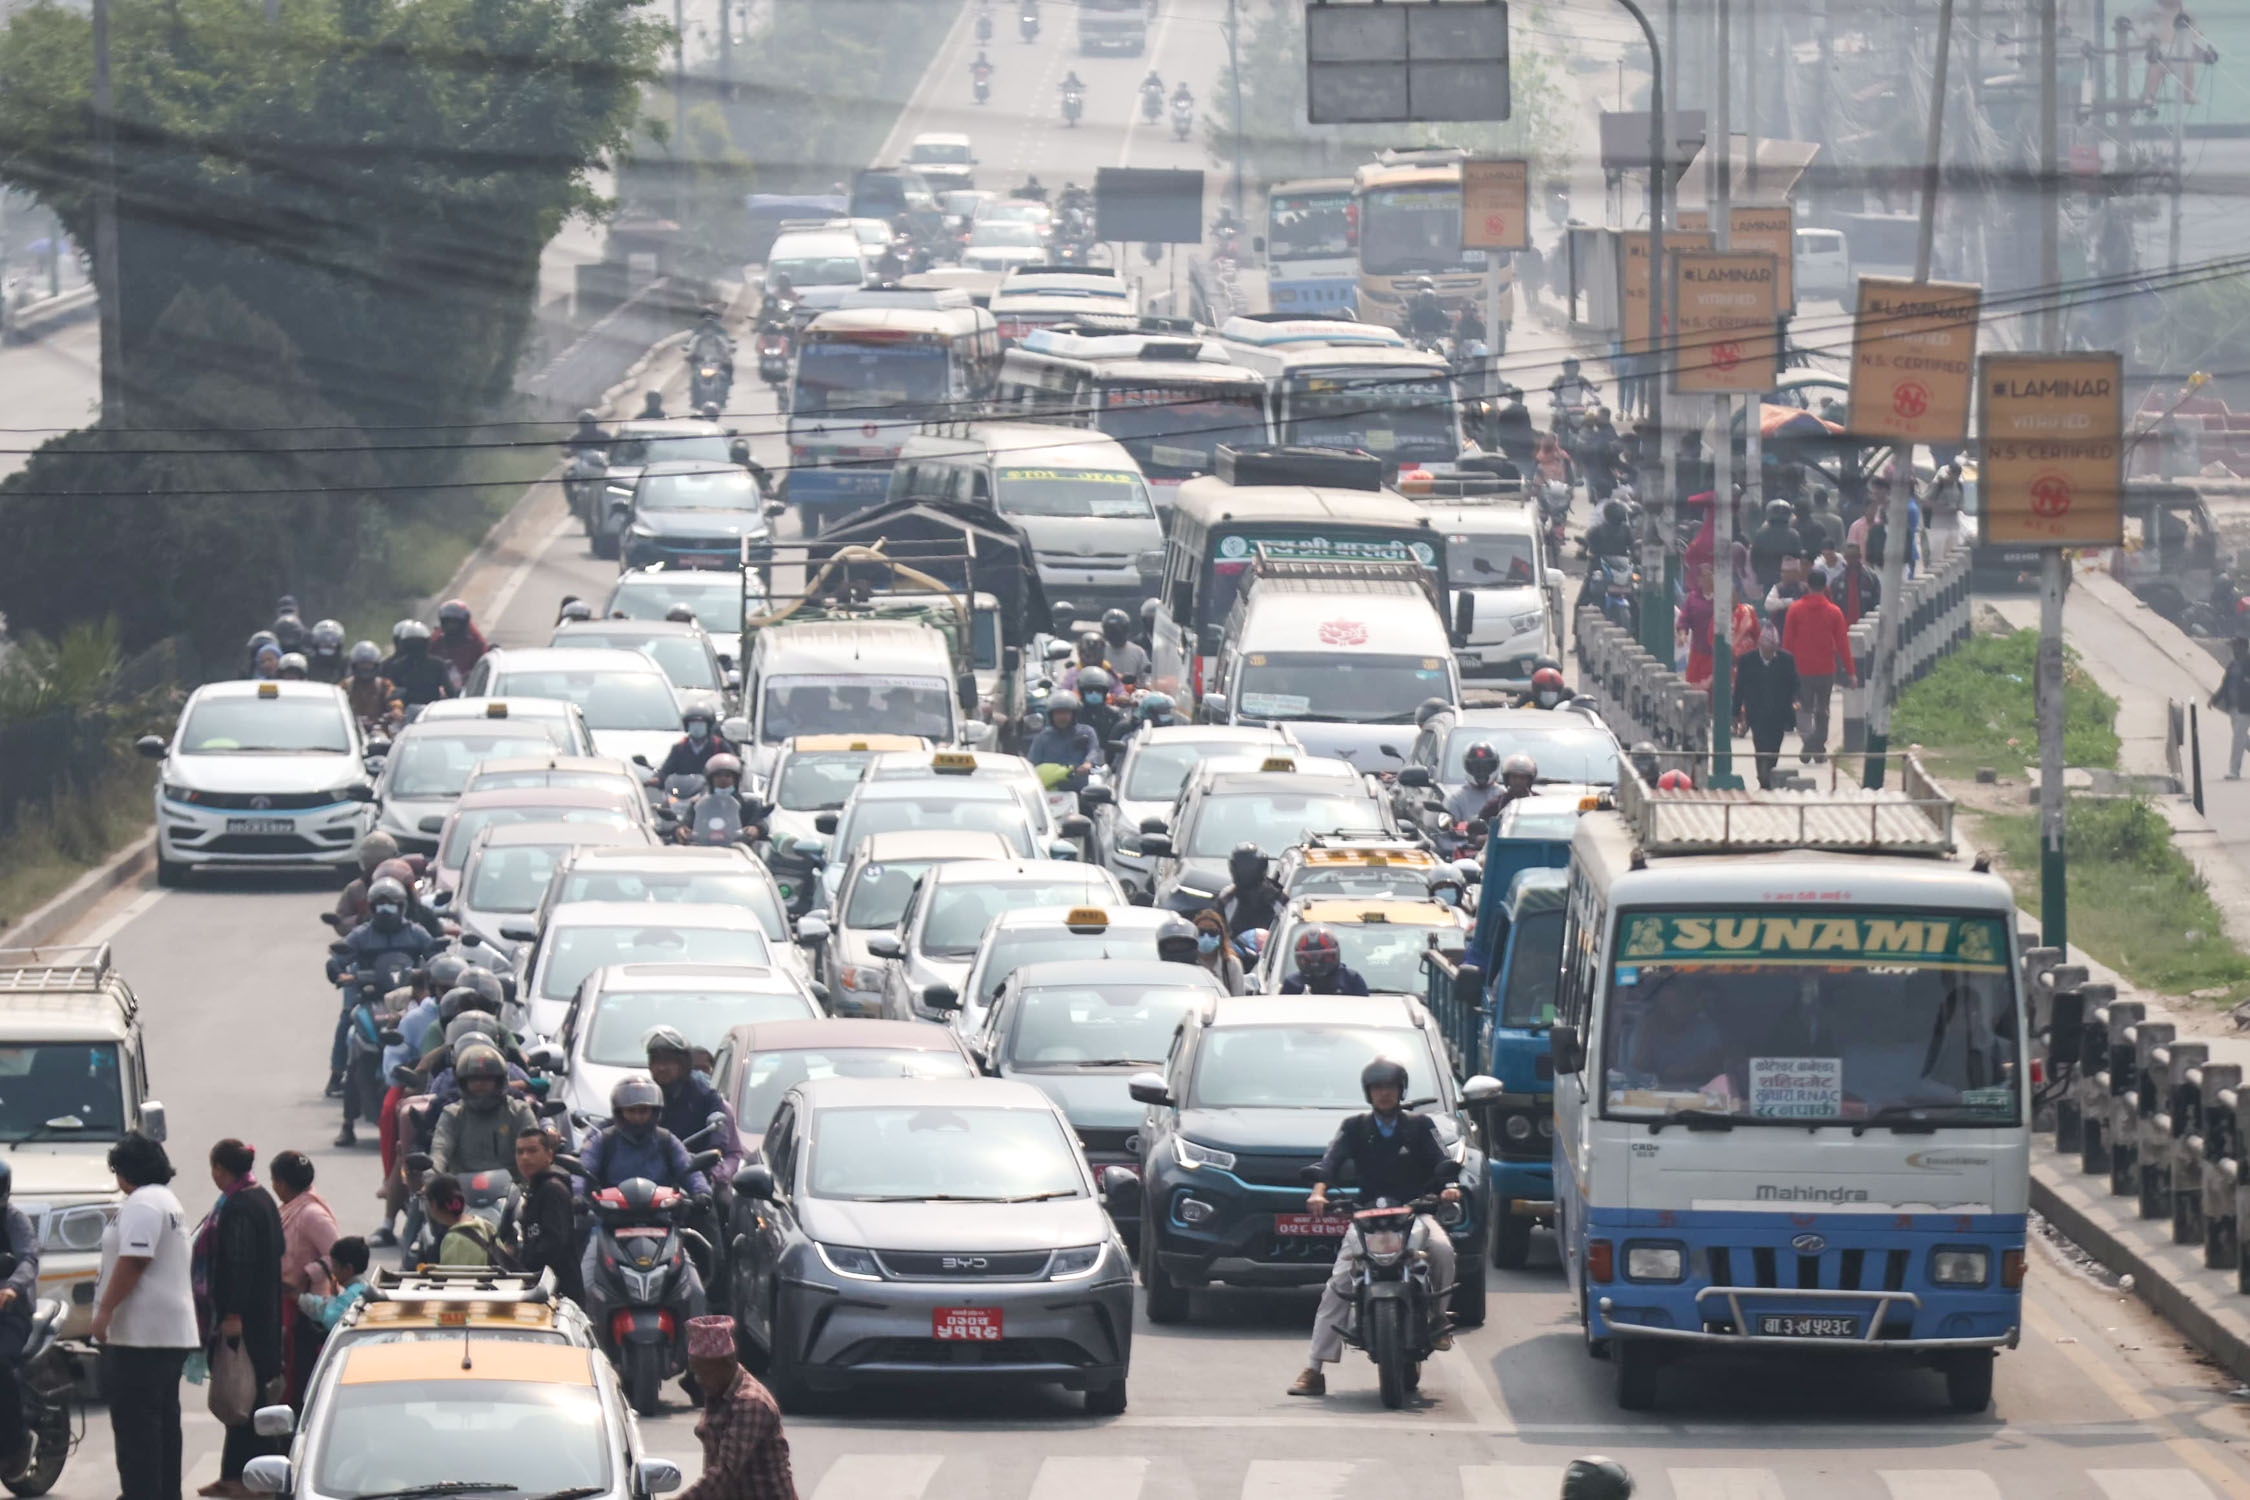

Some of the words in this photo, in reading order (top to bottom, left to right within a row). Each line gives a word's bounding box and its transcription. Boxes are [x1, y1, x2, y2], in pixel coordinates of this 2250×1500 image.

[1732, 220, 1788, 231] LAMINAR
[1696, 268, 1771, 282] LAMINAR
[1697, 294, 1757, 305] VITRIFIED
[1886, 300, 1970, 320] LAMINAR
[1893, 355, 1968, 374] CERTIFIED
[2010, 378, 2110, 398] LAMINAR
[2012, 412, 2091, 431] VITRIFIED
[2026, 442, 2114, 460] CERTIFIED
[1075, 911, 1101, 920] TAXI
[1672, 918, 1949, 951] SUNAMI
[1797, 1089, 1840, 1101] RNAC
[1756, 1184, 1868, 1201] Mahindra
[942, 1257, 988, 1268] BYD
